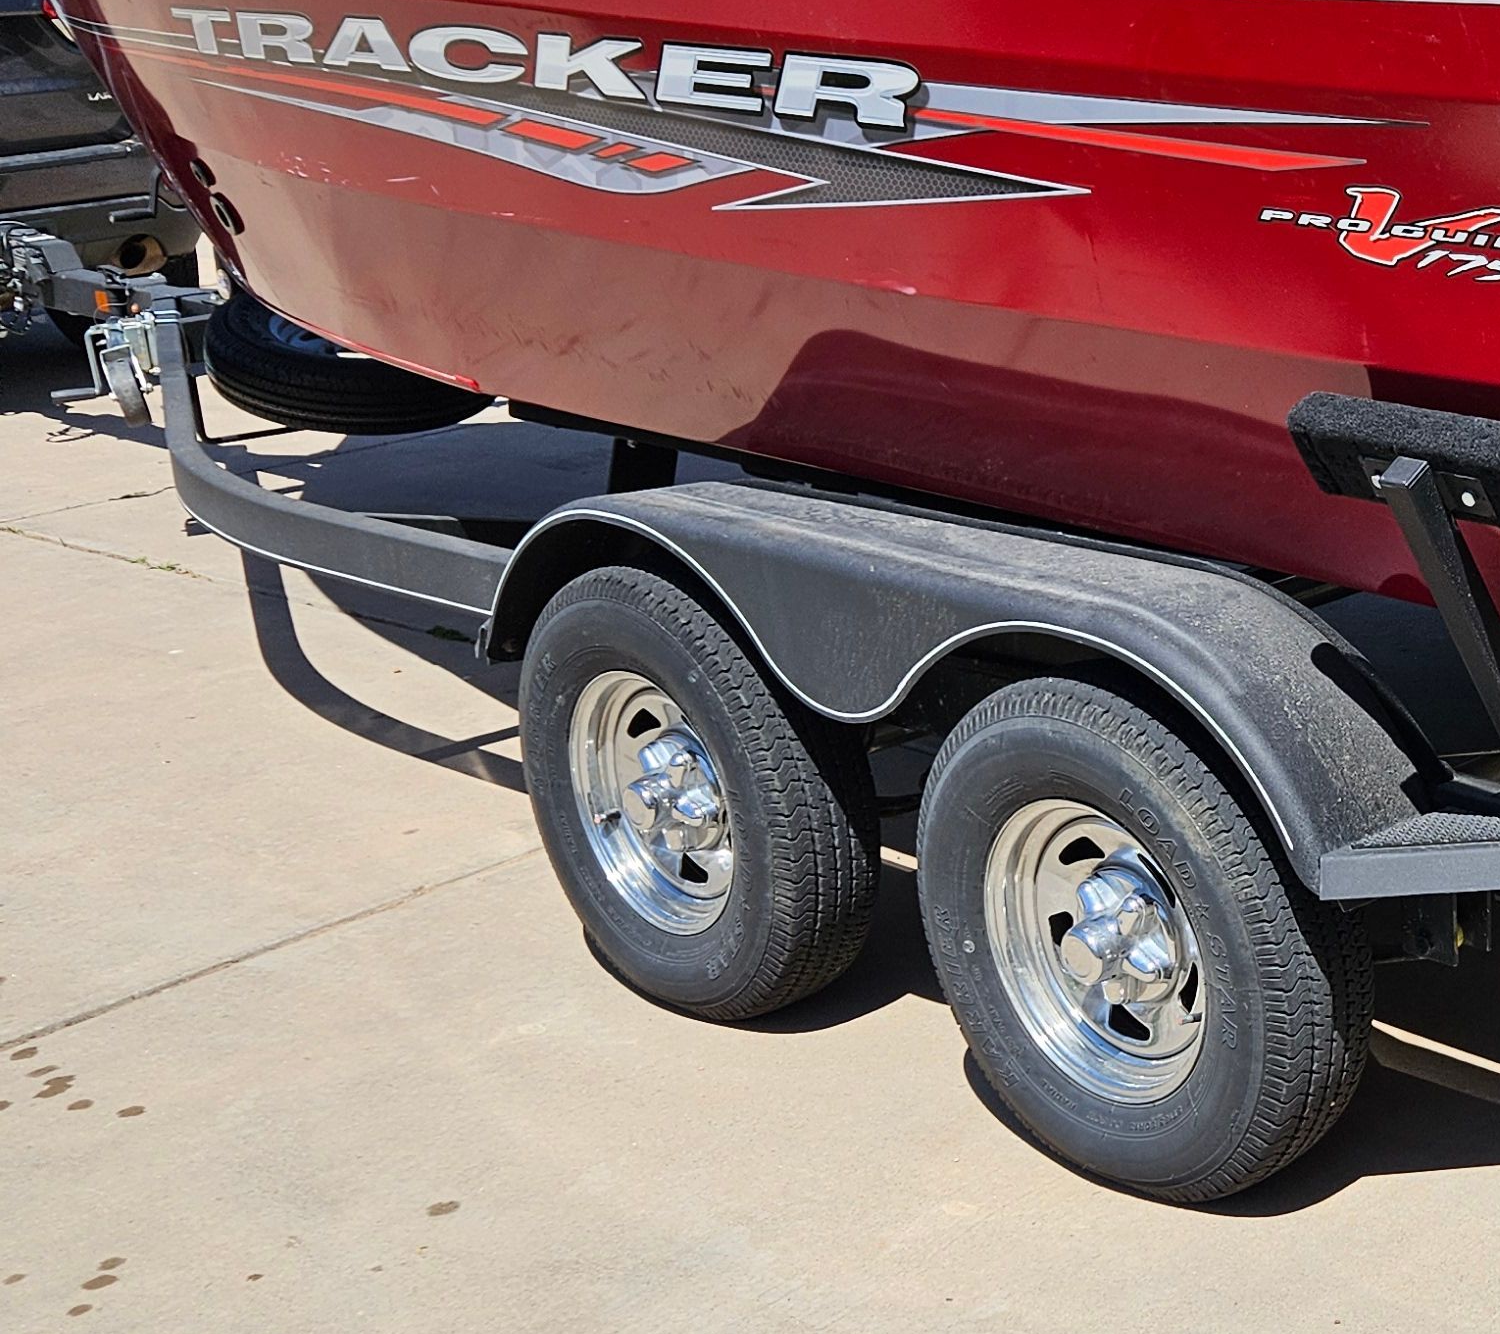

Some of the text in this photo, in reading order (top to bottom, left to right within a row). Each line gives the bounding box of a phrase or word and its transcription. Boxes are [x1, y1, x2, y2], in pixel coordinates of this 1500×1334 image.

[170, 6, 921, 130] TRACKER
[1259, 208, 1373, 232] PRO
[1118, 787, 1239, 1050] LOAD STAR
